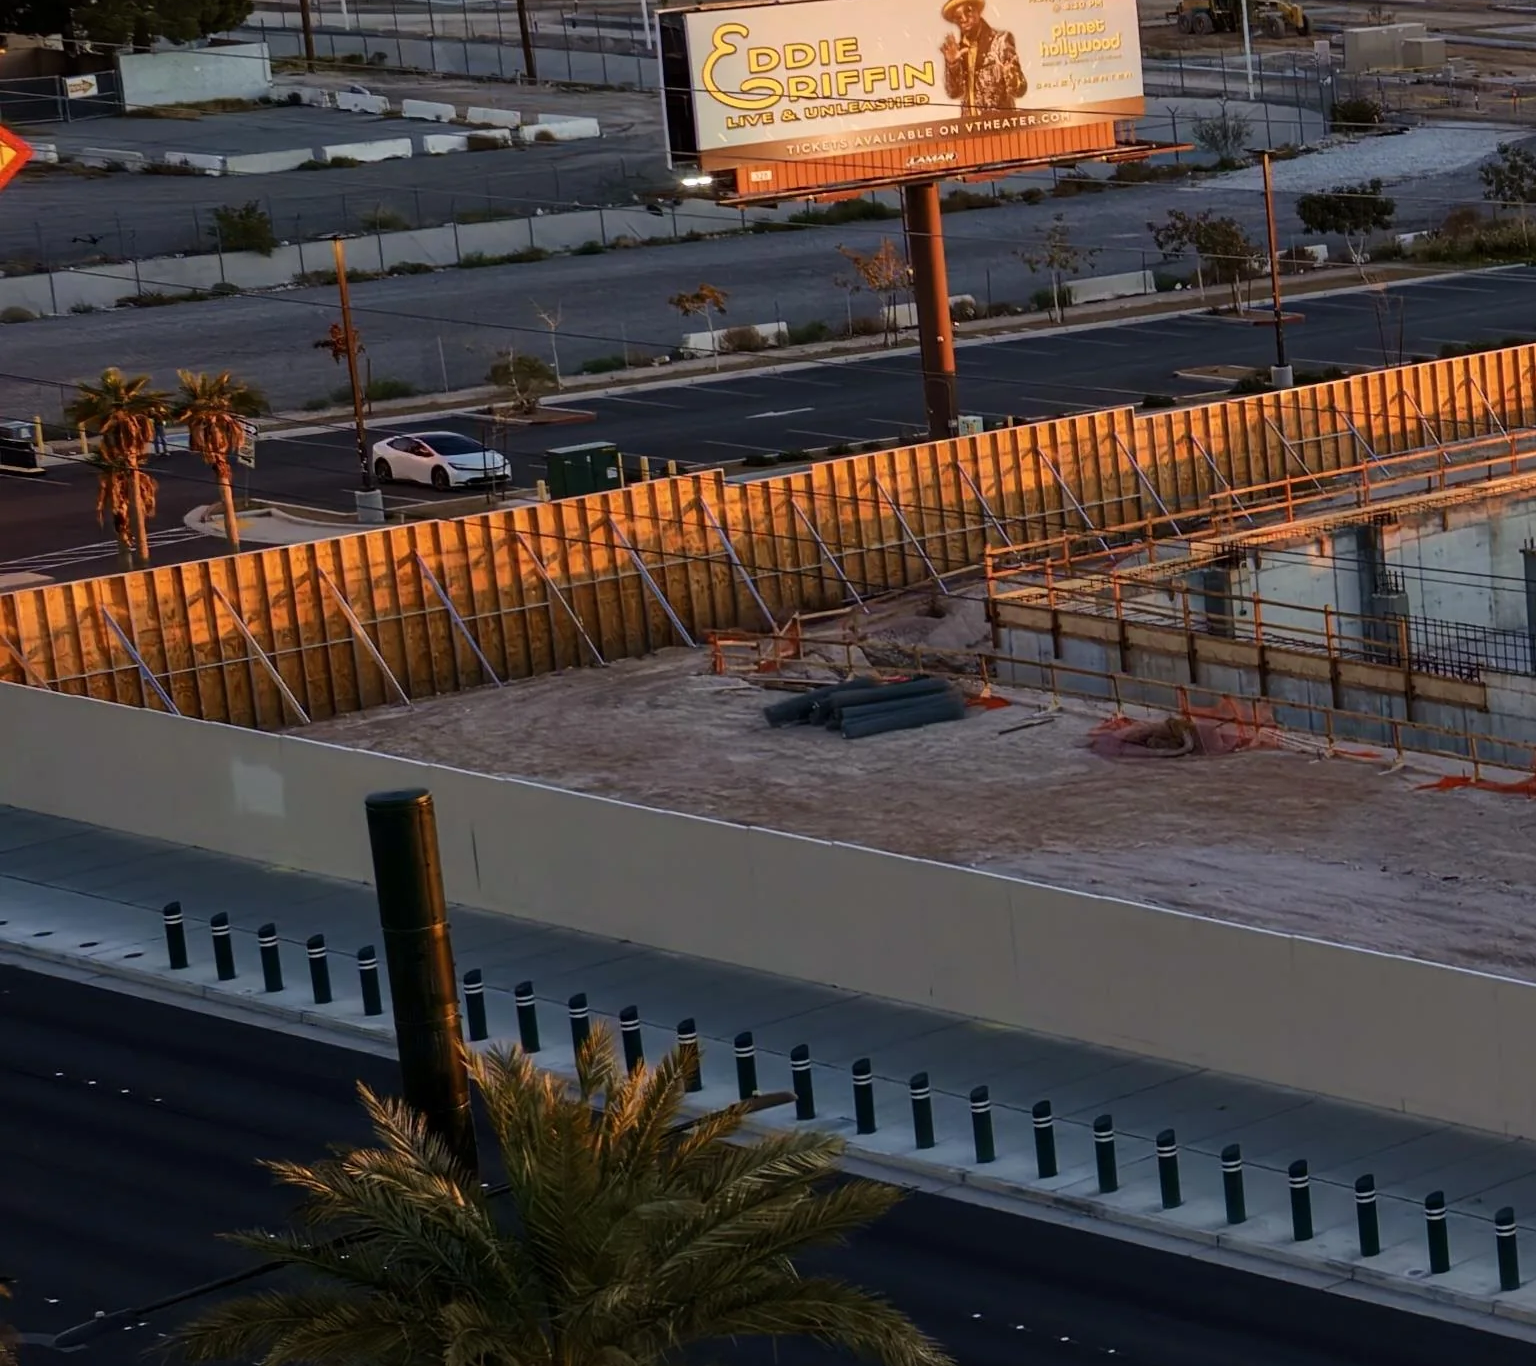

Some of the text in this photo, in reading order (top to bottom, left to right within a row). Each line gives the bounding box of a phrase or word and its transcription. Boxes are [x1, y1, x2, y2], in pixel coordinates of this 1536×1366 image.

[1040, 32, 1122, 59] hollywood
[1051, 19, 1106, 42] planet
[702, 23, 862, 81] EDDIE
[738, 60, 935, 110] GRIFFIN
[726, 93, 930, 129] LIVE & UNLEASHED
[785, 111, 1072, 155] TICKETS AVAILABLE ON VTHEATER.COM
[907, 151, 958, 167] LAMAR
